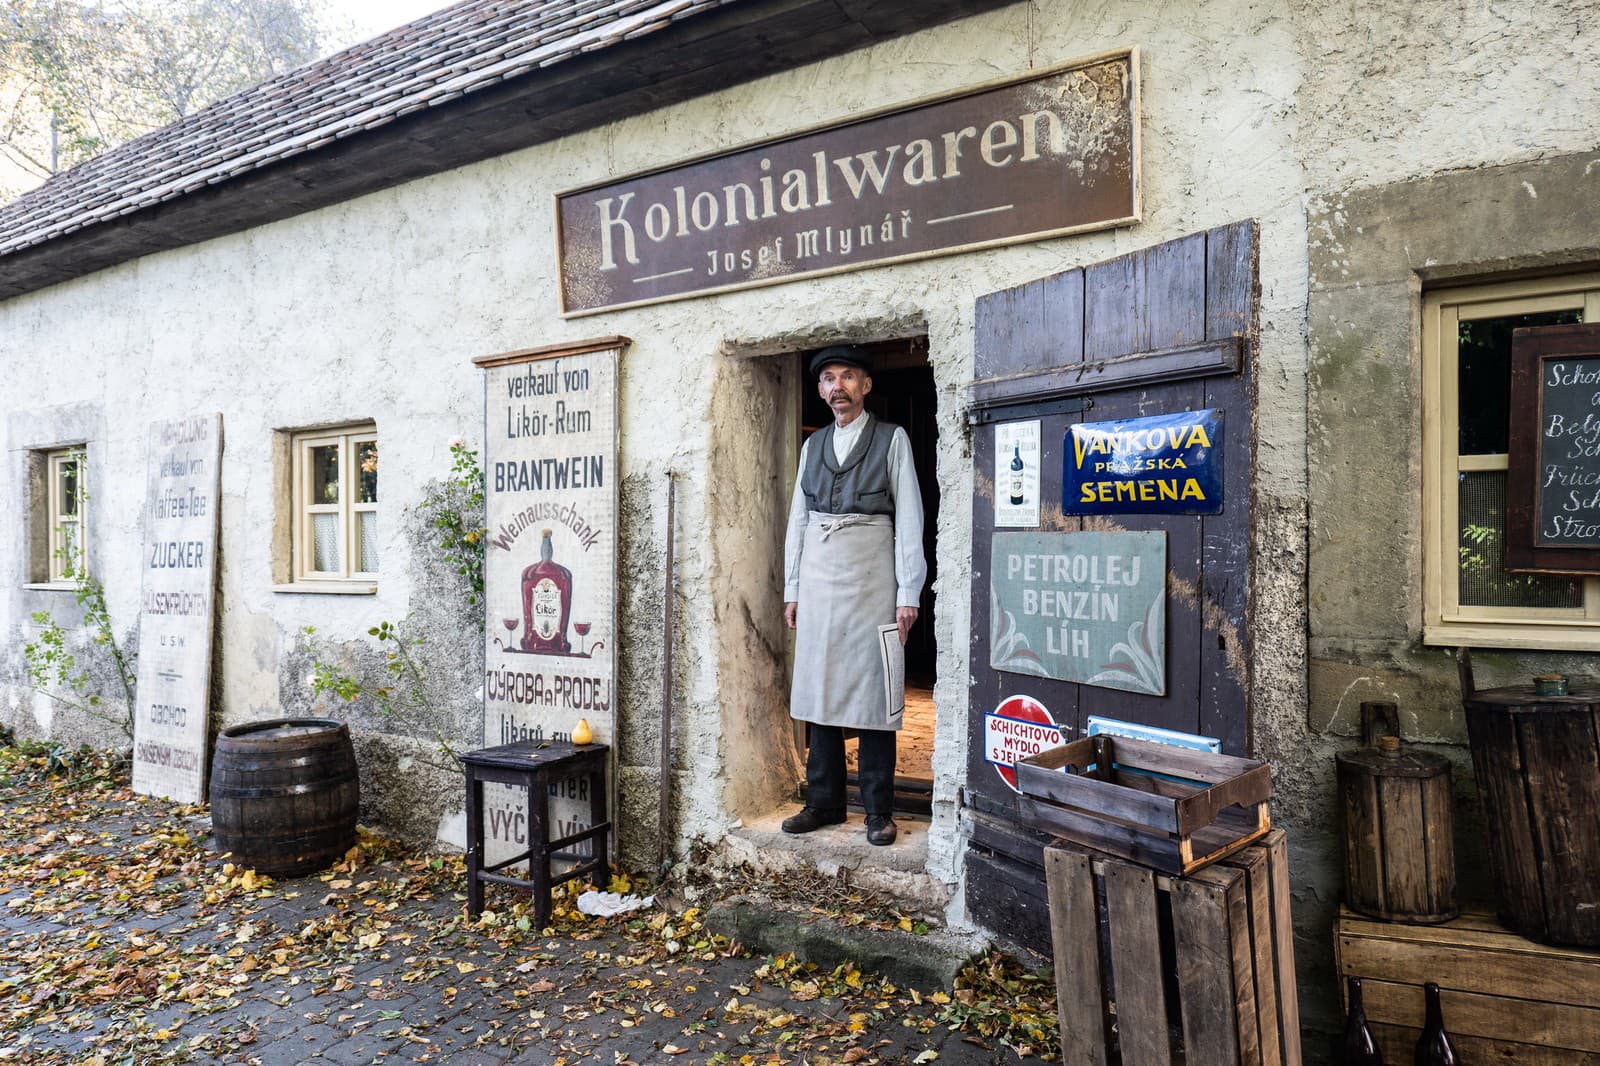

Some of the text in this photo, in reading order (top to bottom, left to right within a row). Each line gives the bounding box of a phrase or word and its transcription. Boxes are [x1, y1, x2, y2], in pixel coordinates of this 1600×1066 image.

[595, 110, 1067, 271] Kolonialwaren
[707, 209, 912, 276] Josef Mlynář
[563, 367, 589, 393] von
[507, 399, 591, 439] Likör-Rum
[1072, 424, 1212, 470] VAŇKOVA
[1095, 453, 1187, 473] PRAŽSKÁ
[495, 455, 603, 493] BRANTWEIN
[1080, 478, 1206, 503] SEMENA
[492, 502, 601, 552] Weinausschank
[150, 541, 203, 569] ZUCKER
[1007, 554, 1141, 586] PETROLEJ
[1023, 584, 1119, 622] BENZÍN
[1046, 619, 1090, 658] LÍH
[486, 664, 543, 705] VÝROBA
[554, 675, 611, 712] PRODEJ
[991, 719, 1059, 744] SCHICHTOVO
[1004, 736, 1040, 755] MÝDLO
